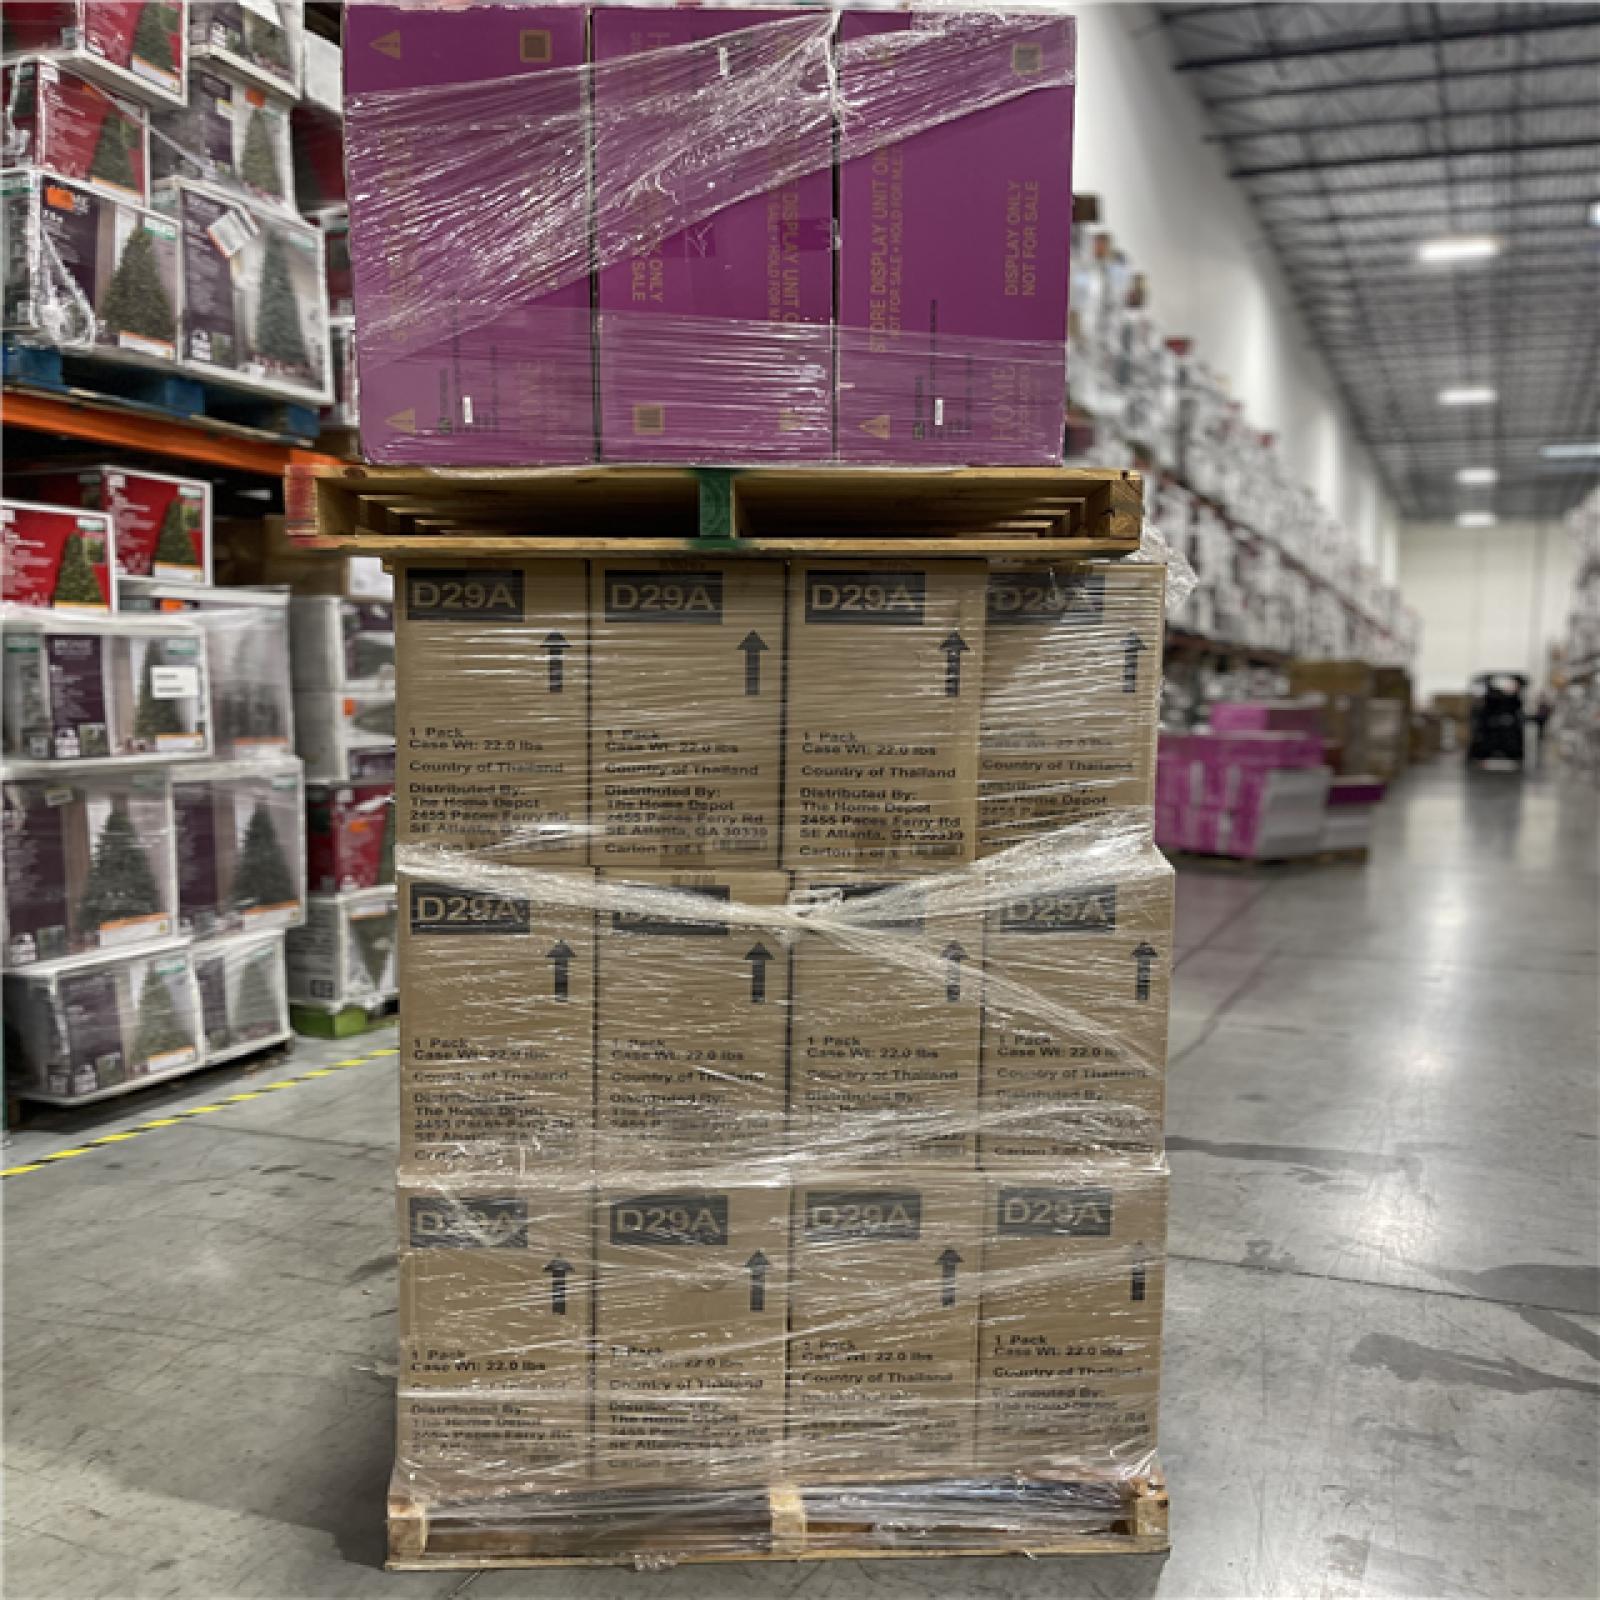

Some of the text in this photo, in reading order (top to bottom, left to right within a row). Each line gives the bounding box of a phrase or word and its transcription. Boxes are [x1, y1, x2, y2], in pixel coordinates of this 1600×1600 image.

[872, 180, 889, 218] UNIT
[781, 192, 800, 264] DISPLAY
[1004, 179, 1021, 296] DISPLAY ONLY
[1021, 180, 1039, 296] NOT FOR SALE
[870, 224, 888, 294] DISPLAY
[889, 254, 902, 285] SALE
[631, 260, 646, 302] SALE
[649, 259, 664, 303] ONLY
[782, 269, 799, 307] UNIT
[889, 287, 901, 313] FOR
[413, 582, 516, 609] D29A
[611, 584, 715, 611] D29A
[811, 584, 916, 611] D29A
[425, 727, 463, 739] Pack
[819, 732, 857, 743] Pack
[410, 739, 544, 751] Case Wt: 22.0 lbs
[605, 742, 644, 753] Case
[680, 742, 711, 753] 22.0
[802, 743, 840, 755] Case
[877, 745, 907, 756] 22.0
[410, 761, 471, 776] Country
[497, 762, 563, 774] Thailand
[692, 764, 758, 776] Thailand
[801, 766, 863, 779] Country
[890, 767, 955, 779] Thailand
[982, 760, 1041, 773] Country
[410, 783, 495, 793] Distributed
[605, 785, 720, 800] Distributed By:
[800, 788, 917, 802] Distributed By:
[493, 798, 539, 809] Depot
[606, 800, 733, 812] The Home Depot
[802, 801, 930, 815] The Home Depot
[410, 810, 445, 820] 2455
[800, 815, 835, 825] 2455
[842, 815, 886, 825] Paces
[892, 816, 934, 830] Ferry
[800, 845, 851, 857] Carton
[430, 1038, 468, 1049] Pack
[825, 1035, 860, 1047] Pack
[415, 1050, 453, 1061] Case
[720, 1050, 744, 1061] lbs
[807, 1048, 845, 1059] Case
[997, 1048, 1035, 1057] Case
[1070, 1047, 1101, 1058] 22.0
[610, 1072, 672, 1085] Country
[892, 1070, 958, 1081] Thailand
[416, 1107, 443, 1115] The
[812, 1204, 914, 1230] D29A
[1003, 1199, 1104, 1225] D29A
[616, 1207, 719, 1234] D29A
[1010, 1335, 1047, 1346] Pack
[427, 1350, 466, 1361] Pack
[1065, 1345, 1096, 1356] 22.0
[411, 1362, 545, 1372] Case Wt: 22.0 lbs
[993, 1367, 1053, 1378] Country
[610, 1379, 670, 1391] Country
[801, 1373, 863, 1385] Country
[887, 1372, 953, 1384] Thailand
